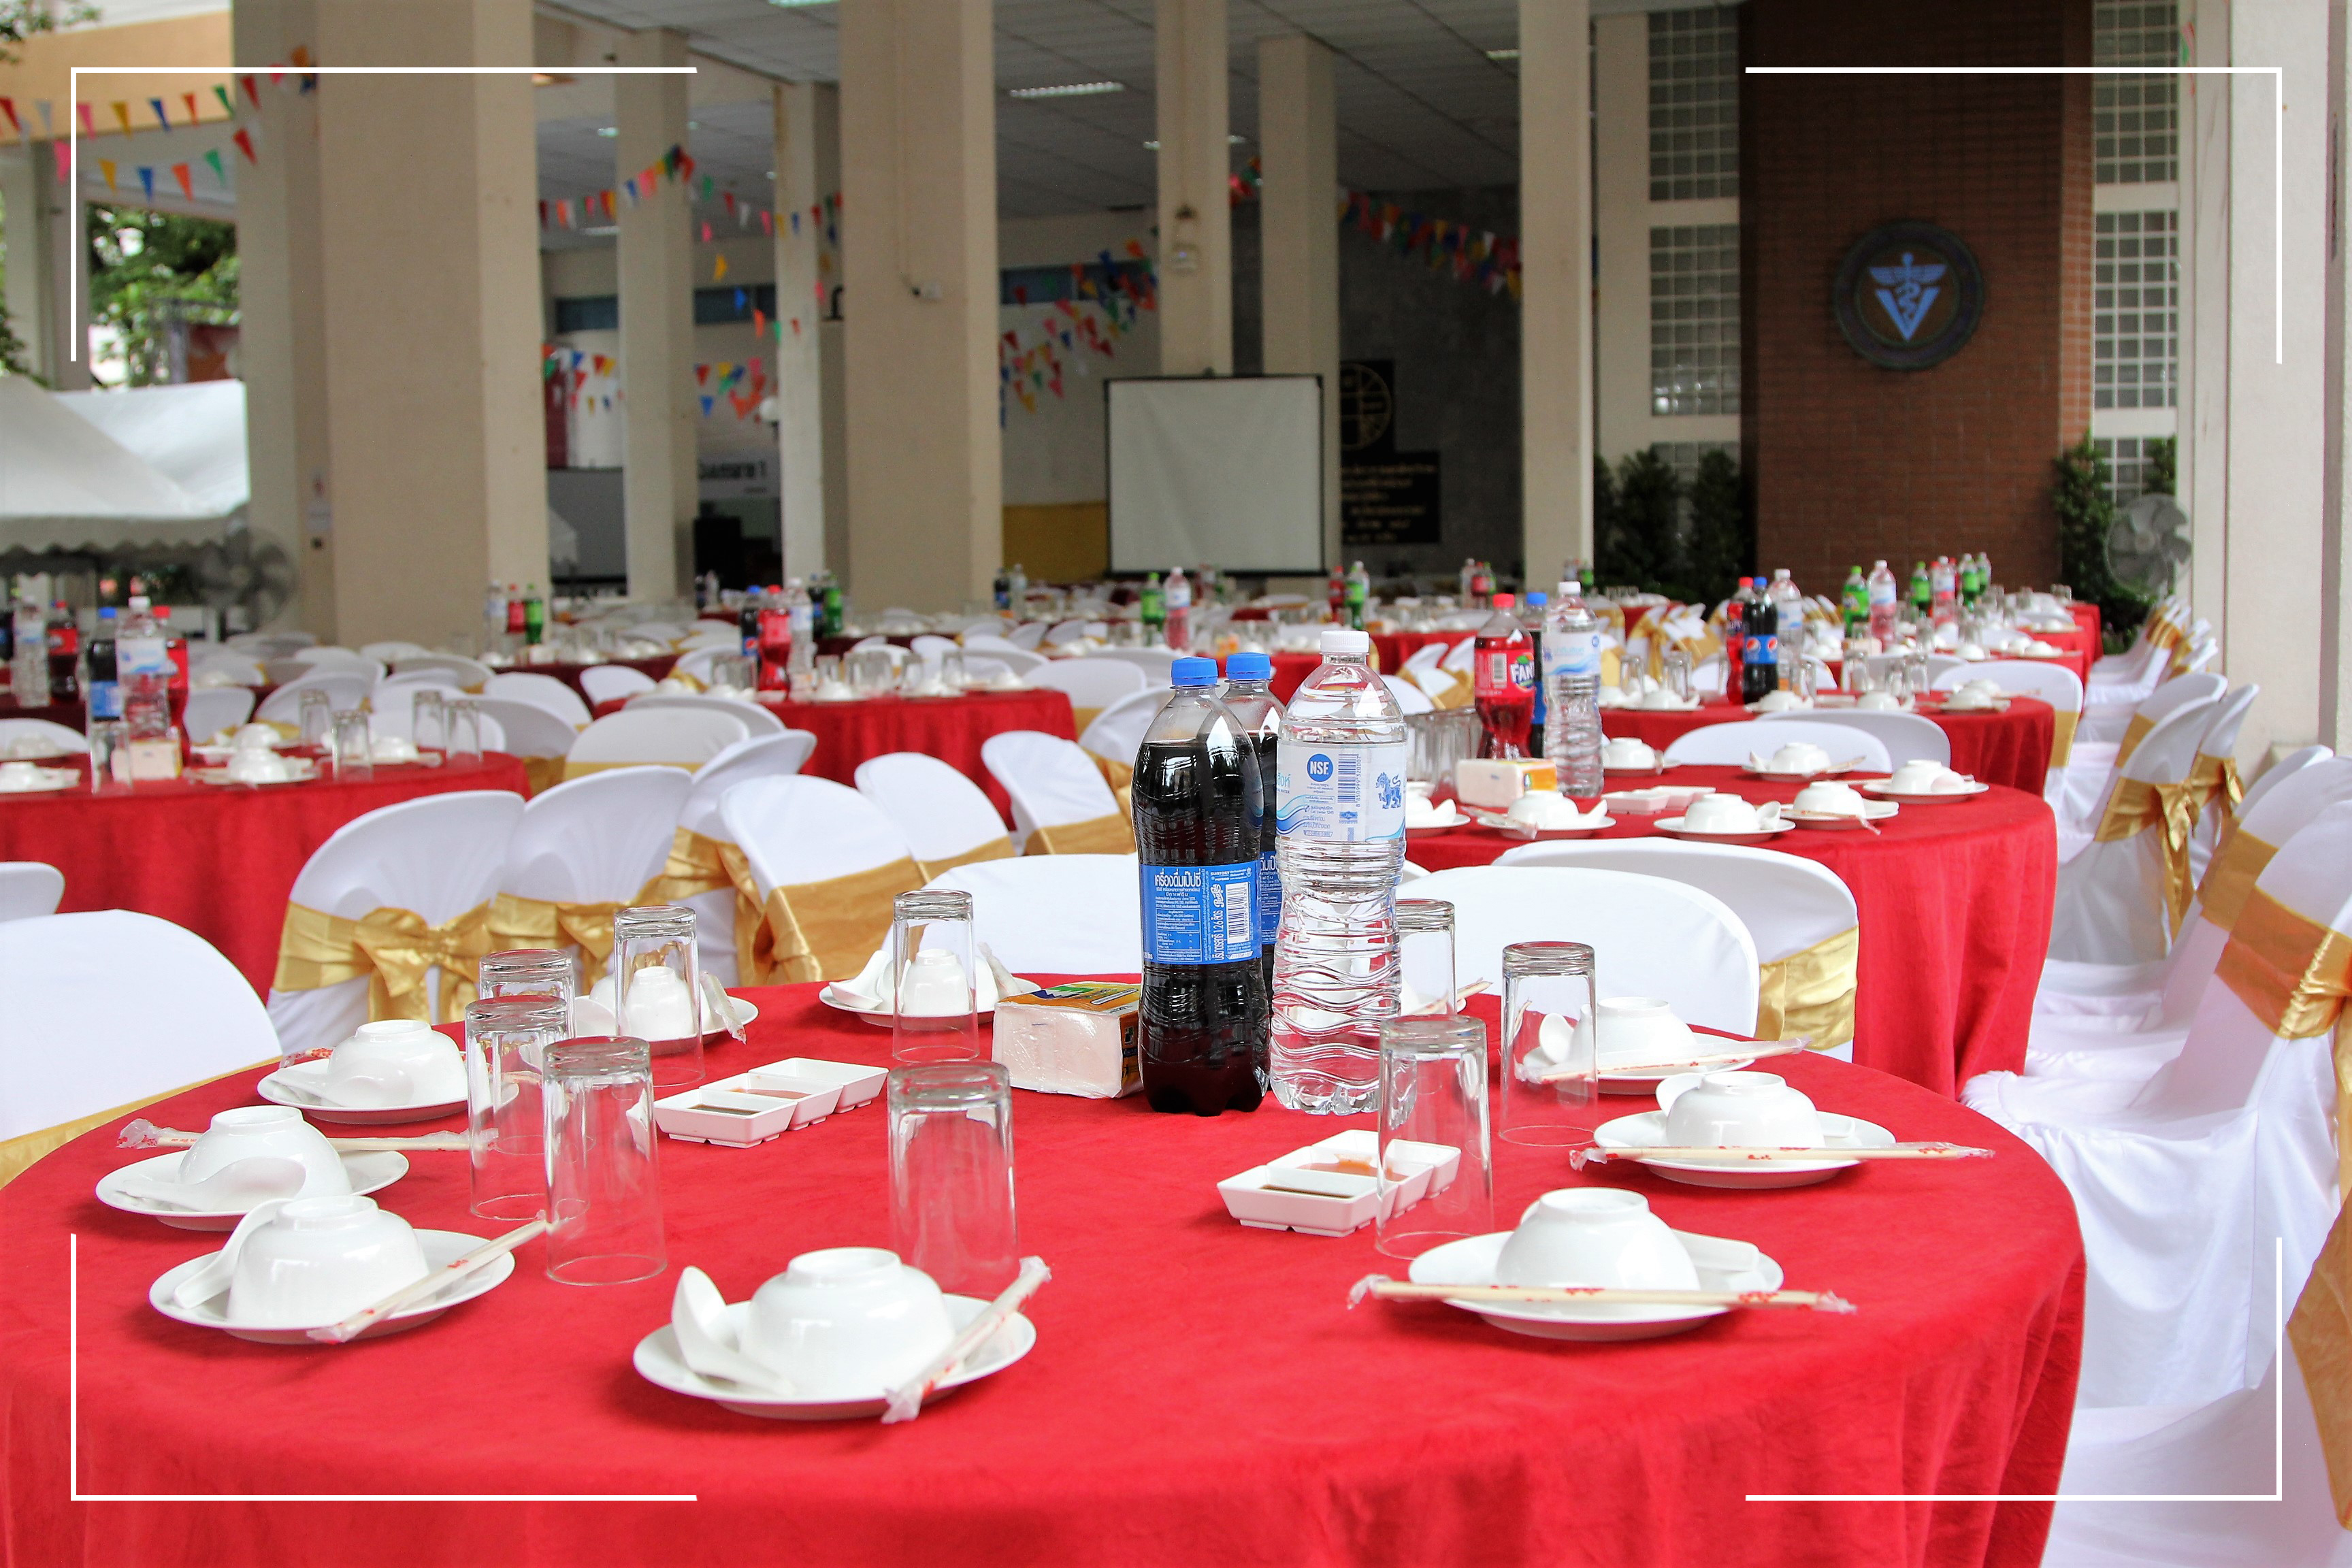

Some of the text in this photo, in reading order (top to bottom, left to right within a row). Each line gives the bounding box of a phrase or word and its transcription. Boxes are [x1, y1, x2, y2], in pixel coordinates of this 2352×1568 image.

[1309, 761, 1329, 775] NSF
[1154, 868, 1201, 887] เครื่องดื่มเป๊ปซี่
